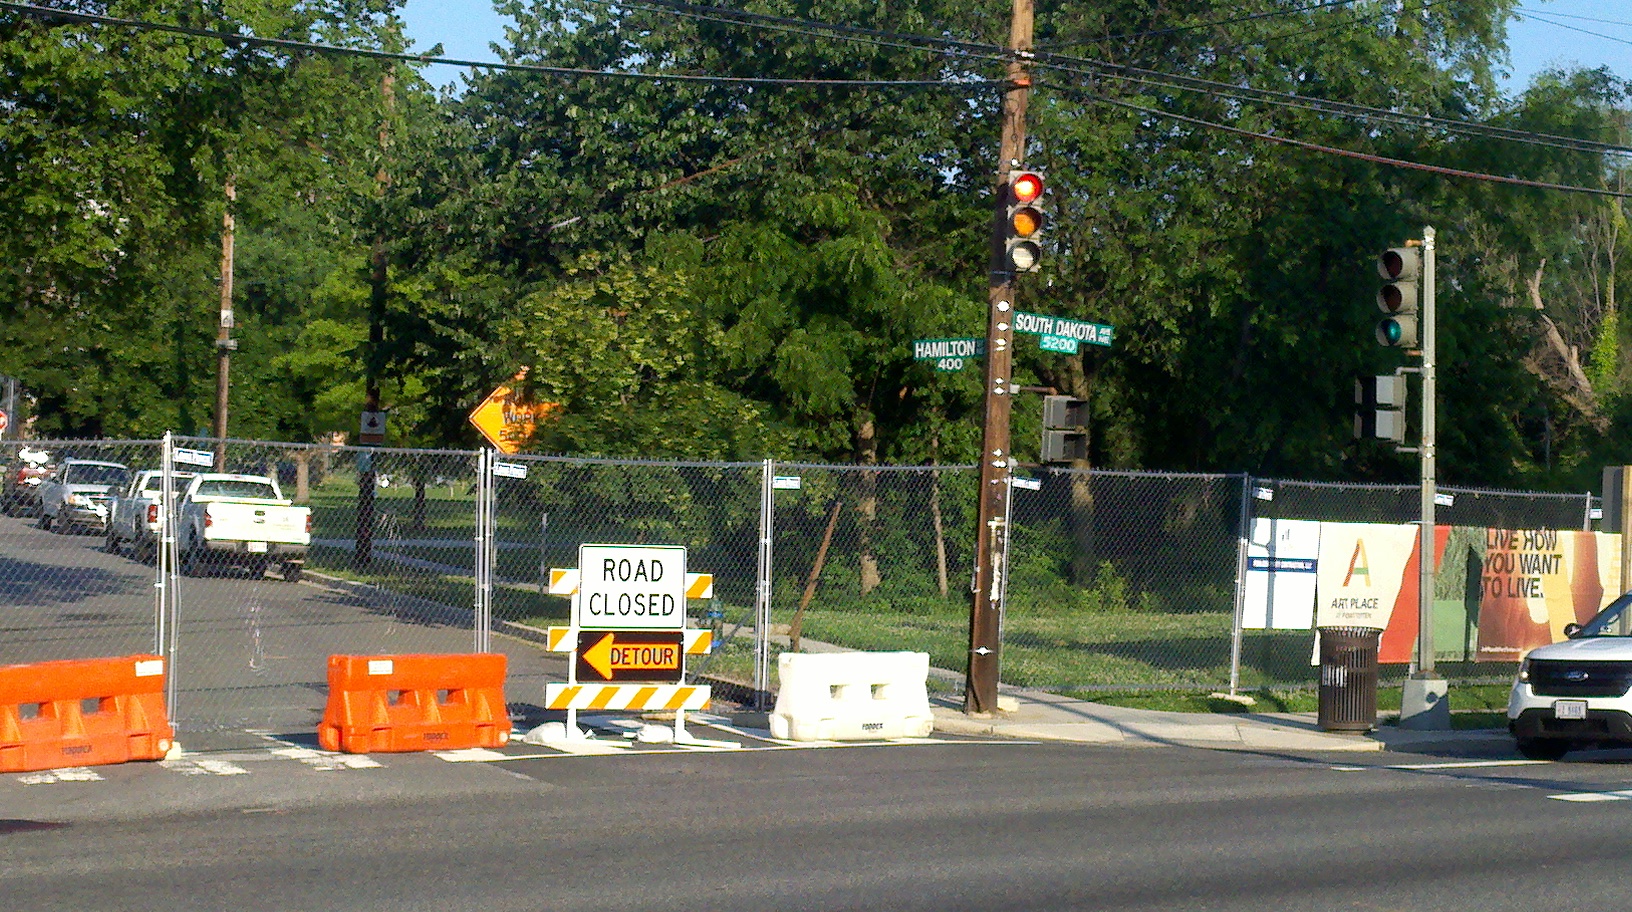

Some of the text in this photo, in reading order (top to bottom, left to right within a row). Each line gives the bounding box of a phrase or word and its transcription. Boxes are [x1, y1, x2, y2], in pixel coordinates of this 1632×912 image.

[1015, 313, 1054, 335] SOUTH
[1056, 320, 1097, 342] DAKOTA
[915, 340, 976, 358] HAMILTON
[1043, 336, 1076, 352] 5200
[938, 358, 963, 370] 400
[1487, 529, 1518, 550] LIVE
[604, 558, 663, 582] ROAD
[1485, 553, 1562, 575] YOU WANT
[1483, 576, 1544, 598] TO LIVE.
[589, 592, 674, 616] CLOSED
[1331, 597, 1379, 610] ART PLACE
[611, 648, 673, 665] DETOUR
